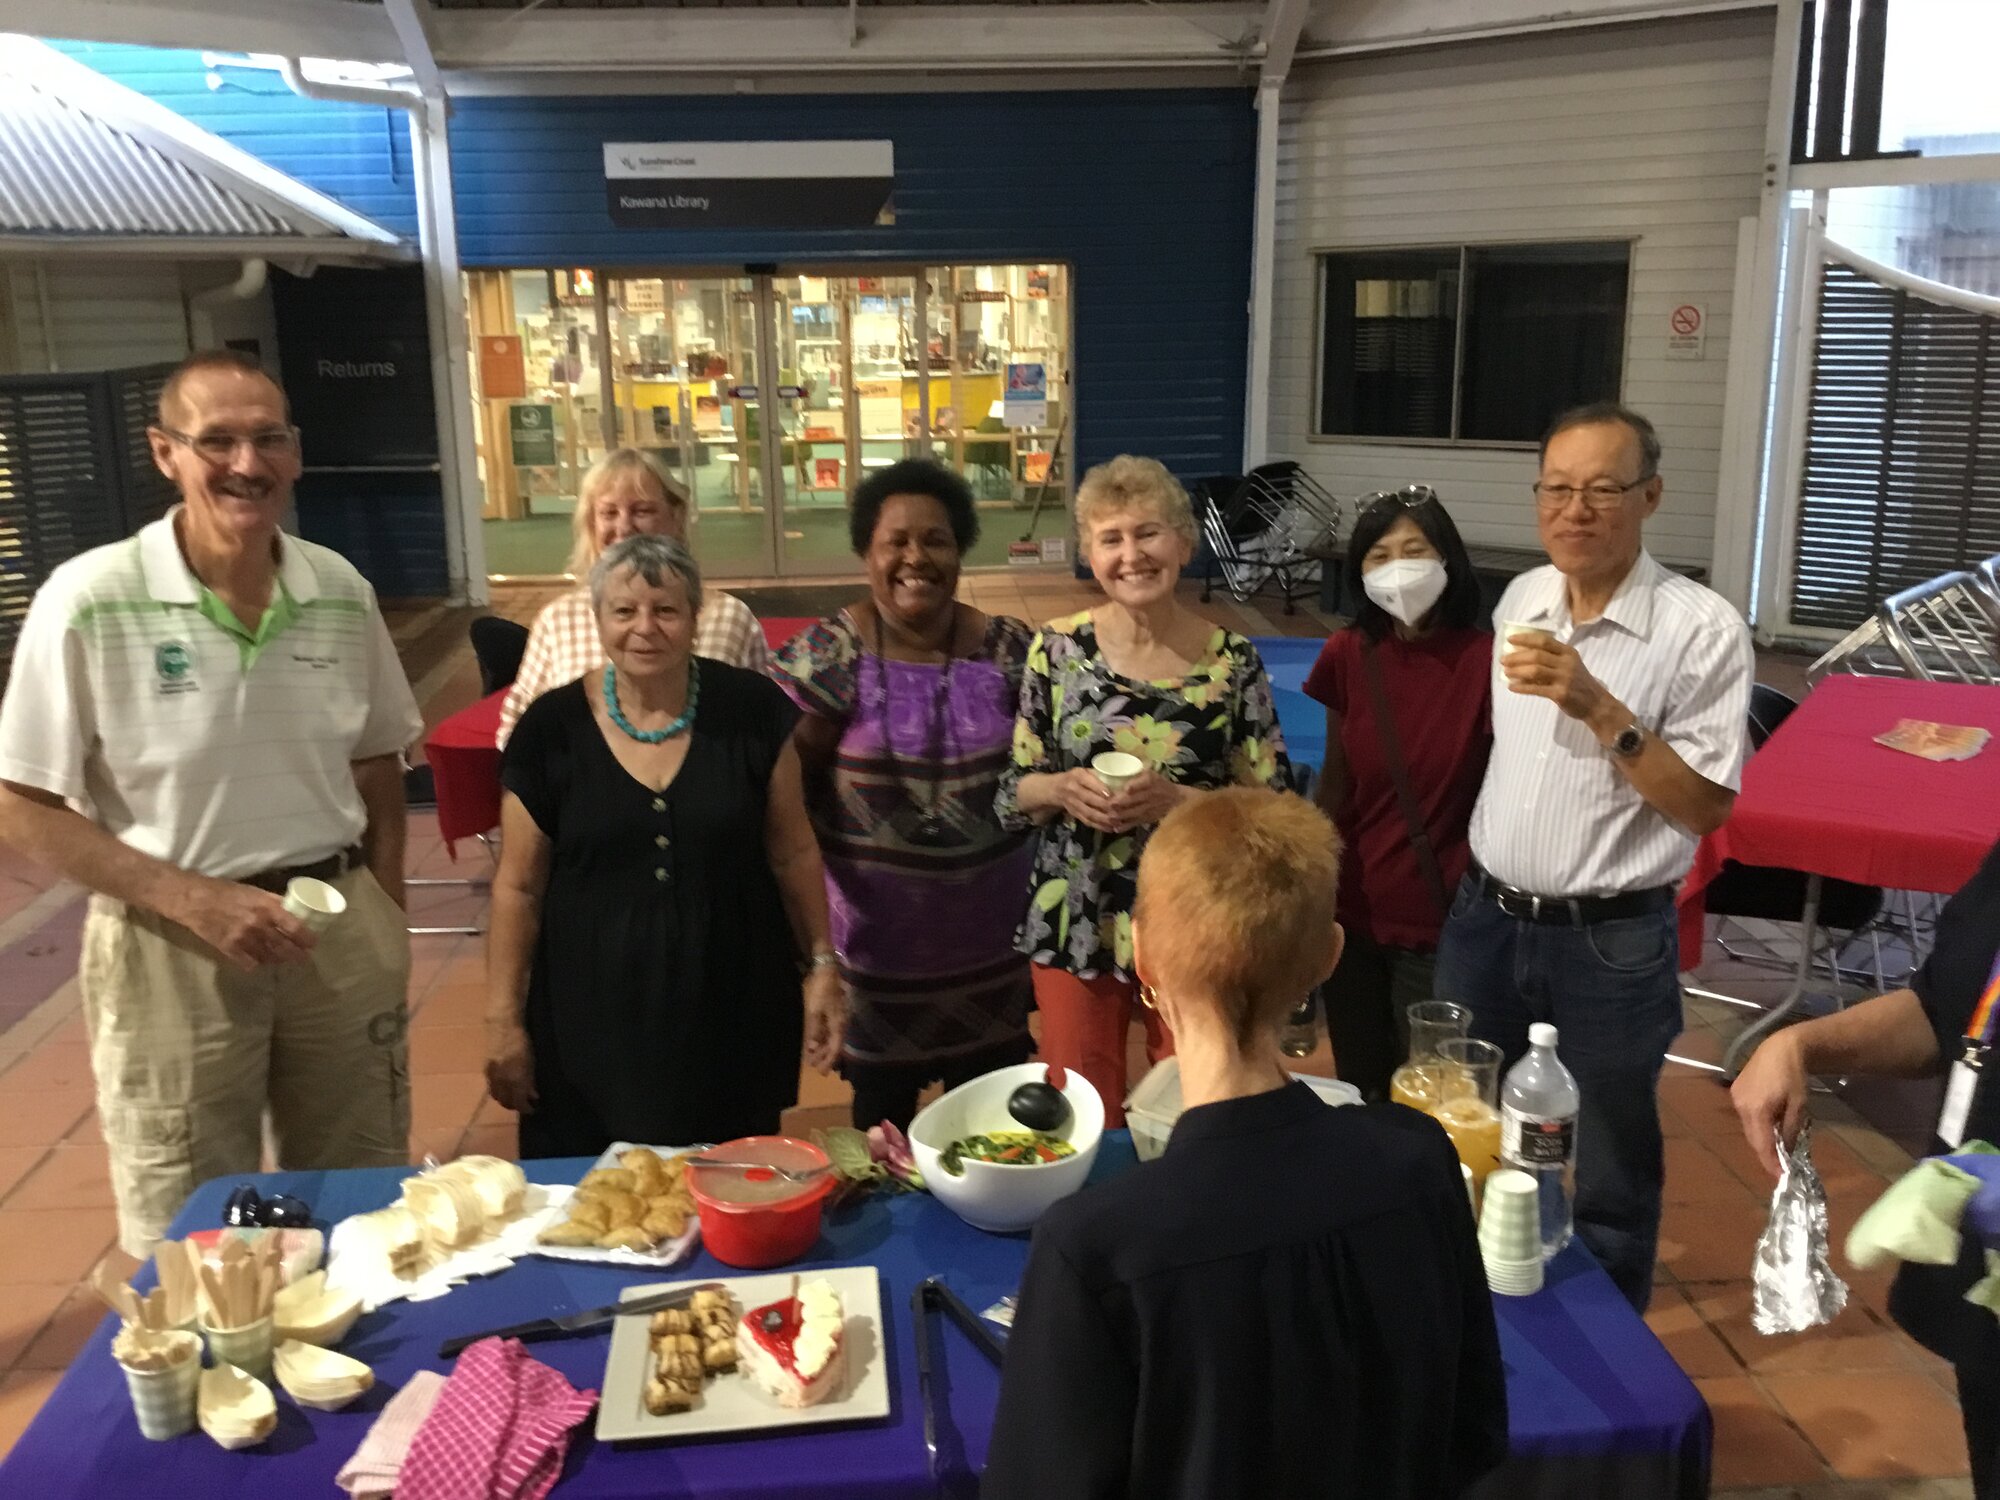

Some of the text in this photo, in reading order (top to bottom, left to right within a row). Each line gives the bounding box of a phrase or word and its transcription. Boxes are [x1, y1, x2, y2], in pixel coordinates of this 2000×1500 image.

[620, 195, 710, 210] Kawana Library
[317, 359, 396, 377] Returns
